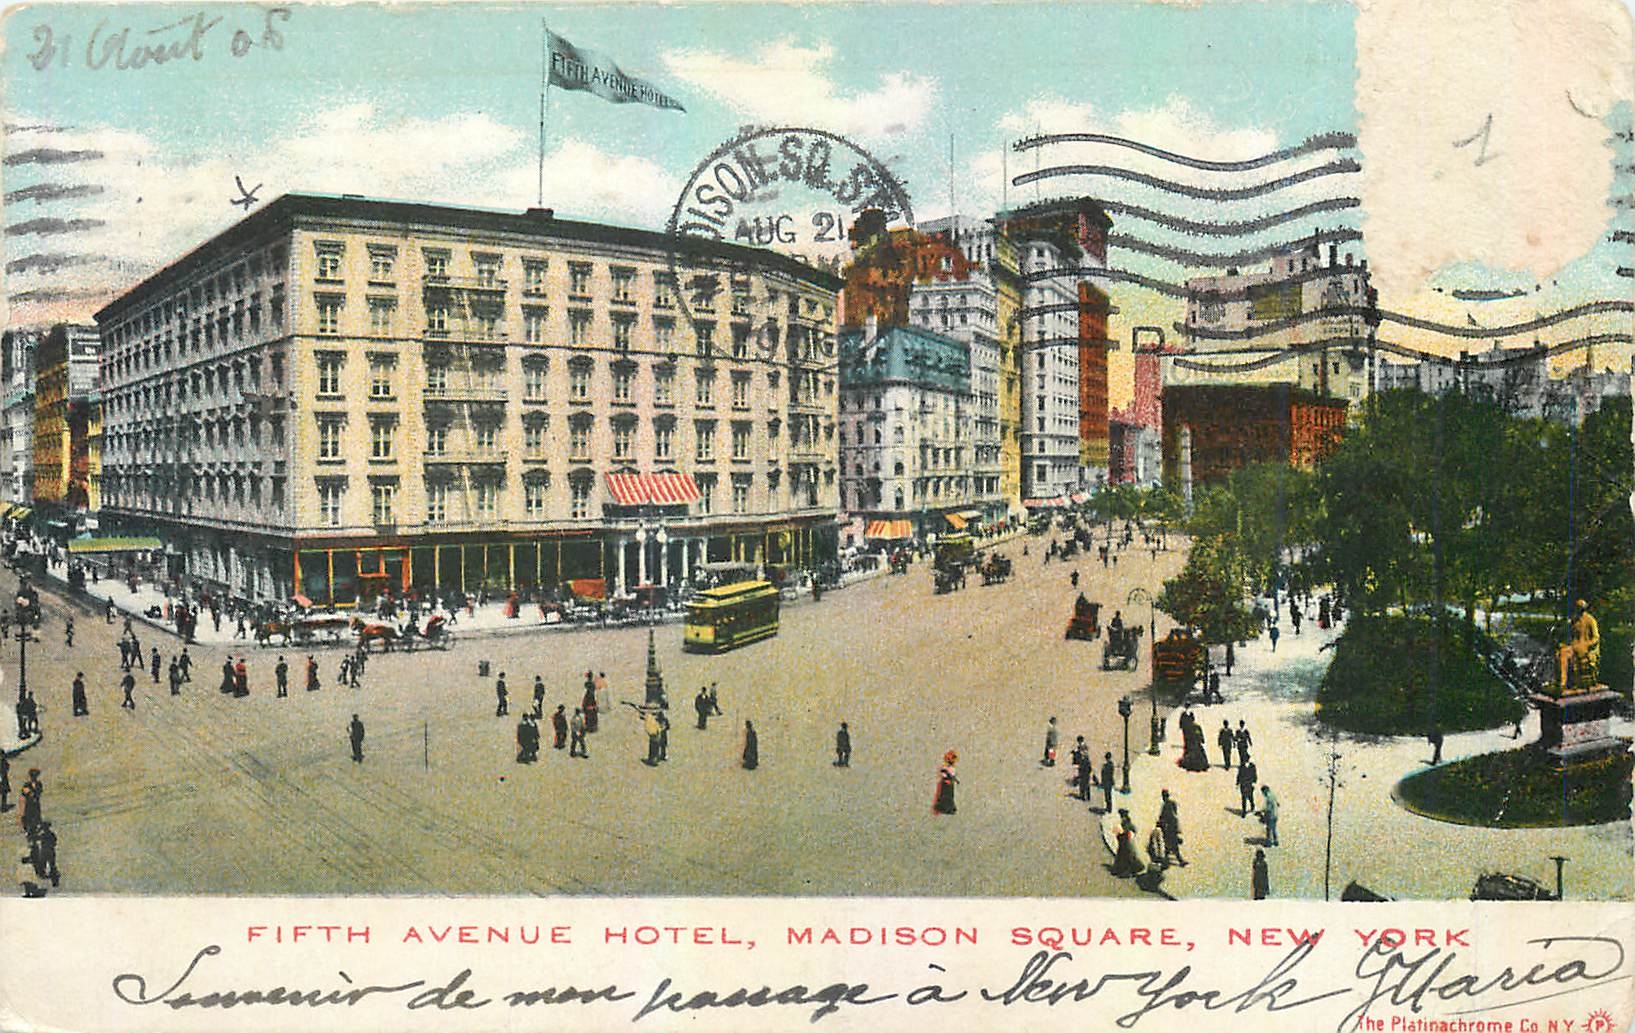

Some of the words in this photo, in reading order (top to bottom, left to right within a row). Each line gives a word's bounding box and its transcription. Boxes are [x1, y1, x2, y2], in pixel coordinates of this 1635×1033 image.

[552, 51, 588, 84] FIFTH
[591, 66, 637, 98] AVENUE
[735, 215, 796, 246] AUG
[812, 211, 845, 242] 21
[113, 946, 424, 1008] Souvenir
[408, 968, 493, 1009] de
[503, 984, 636, 1008] mon
[632, 977, 899, 1023] passage
[907, 964, 967, 1005] à
[981, 950, 1104, 1006] New
[1114, 932, 1352, 1028] York
